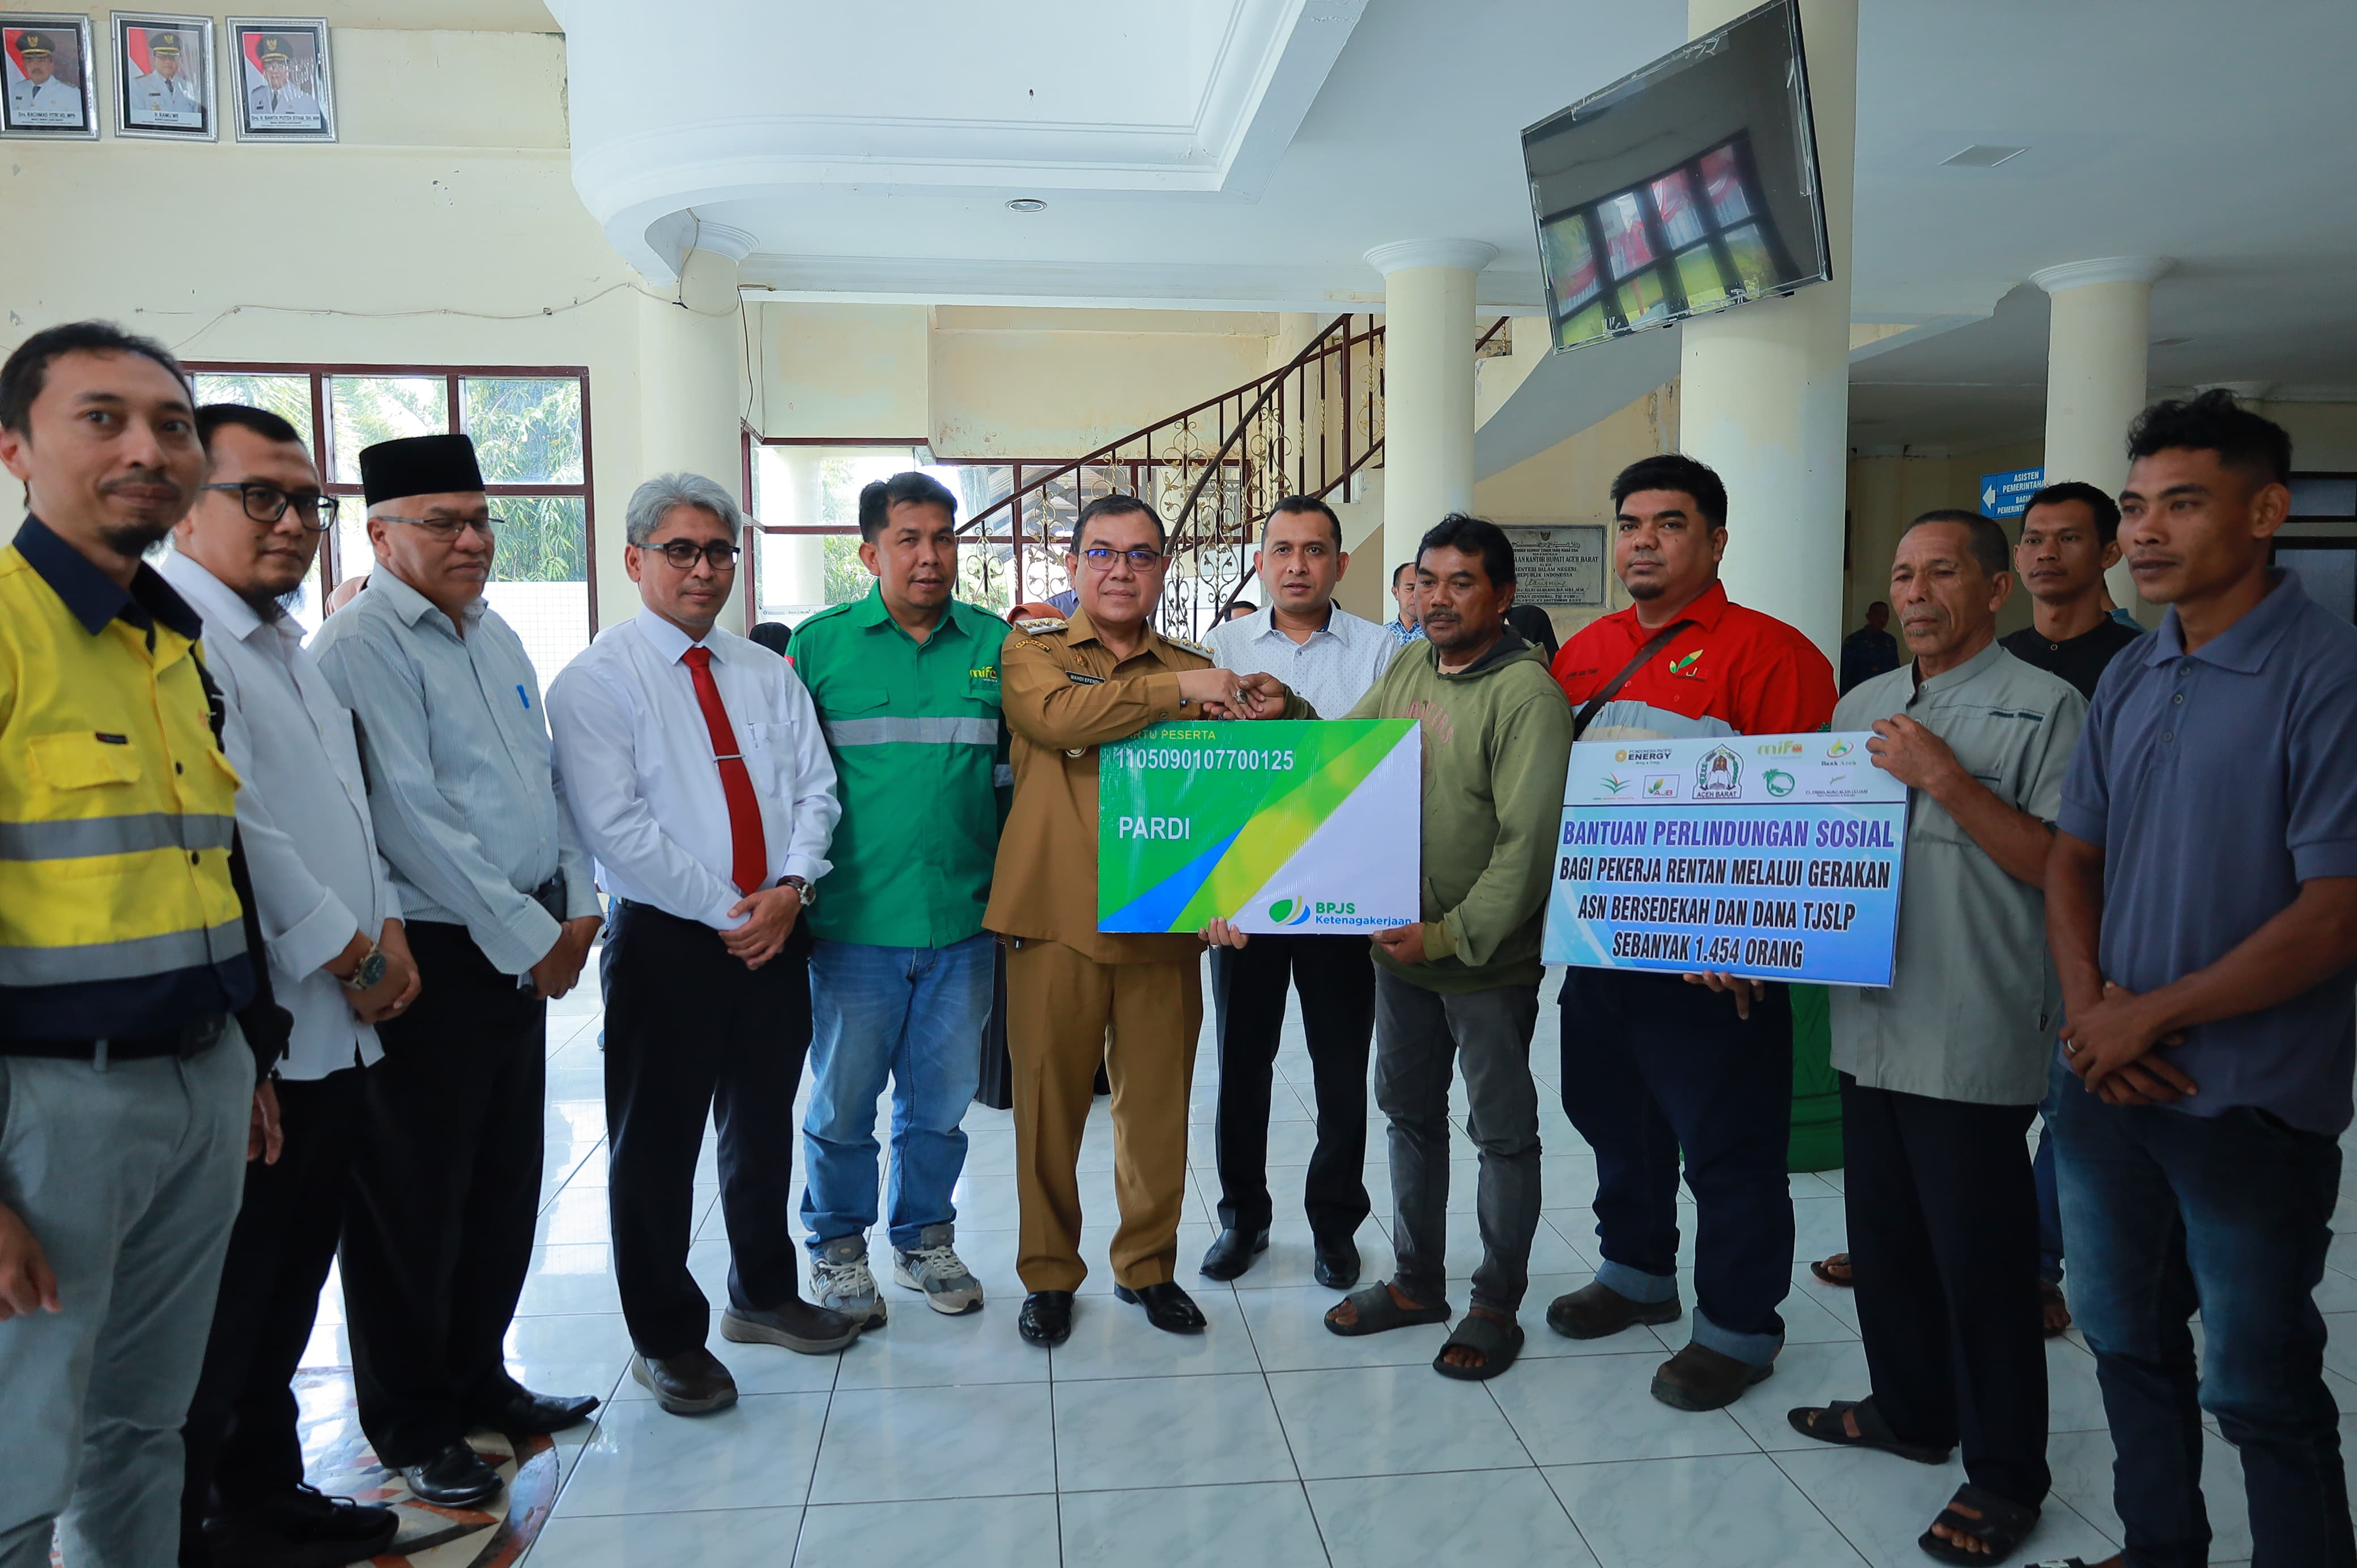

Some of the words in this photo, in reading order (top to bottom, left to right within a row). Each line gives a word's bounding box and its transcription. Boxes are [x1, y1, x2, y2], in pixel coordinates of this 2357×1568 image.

[2014, 471, 2039, 482] ASISTEN
[2002, 480, 2045, 493] PEMERINTAHA
[2016, 495, 2033, 504] BAGIA
[1162, 729, 1216, 740] PESERTA
[1116, 748, 1295, 770] 1105090107700125
[1628, 752, 1671, 761] ENERGY
[1118, 816, 1190, 840] PARDI
[1563, 820, 1647, 845] BANTUAN
[1653, 820, 1809, 846] PERLINDUNGAN
[1815, 820, 1894, 847] SOSIAL
[1559, 856, 1594, 881] BAGI
[1596, 857, 1661, 883] PEKERJA
[1666, 858, 1727, 884] RENTAN
[1730, 859, 1803, 886] MELALUI
[1808, 860, 1891, 888] GERAKAN
[1316, 902, 1355, 914] BPJS
[1577, 894, 1607, 920] ASN
[1611, 895, 1711, 924] BERSEDEKAH
[1714, 899, 1748, 926] DAN
[1752, 900, 1796, 928] DANA
[1803, 902, 1856, 931] TJSLP
[1316, 915, 1412, 926] Ketenagakerjaan
[1613, 931, 1691, 961] SEBANYAK
[1695, 935, 1740, 964] 1.454
[1745, 938, 1803, 968] ORANG
